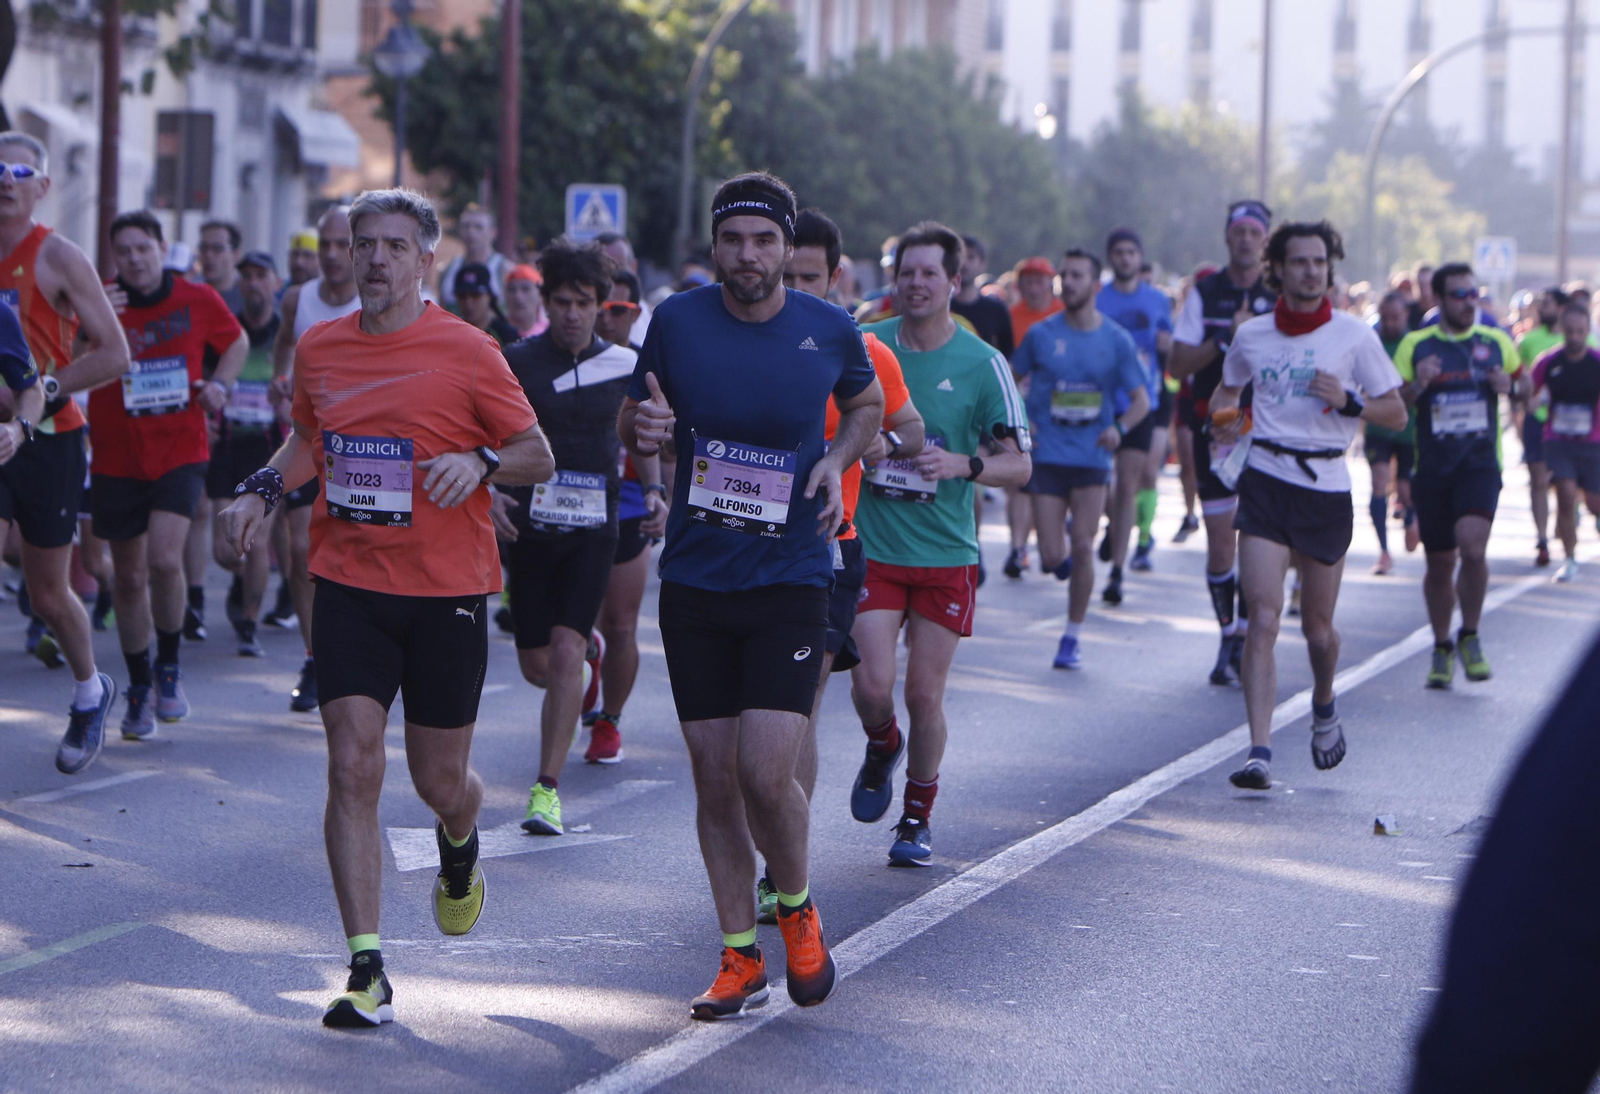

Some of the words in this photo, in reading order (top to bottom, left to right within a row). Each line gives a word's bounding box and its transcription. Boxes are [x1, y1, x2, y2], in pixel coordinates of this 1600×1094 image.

[721, 201, 773, 212] LURBEL
[798, 344, 819, 352] adidas
[141, 359, 180, 371] ZURICH
[345, 441, 401, 456] ZURICH
[728, 447, 785, 468] ZURICH
[345, 472, 382, 488] 7023
[560, 474, 599, 487] ZURICH
[885, 473, 908, 486] PAUL
[723, 477, 761, 496] 7394
[348, 493, 376, 506] JUAN
[556, 496, 584, 509] 9094
[712, 497, 763, 516] ALFONSO
[532, 509, 569, 521] RICARDO
[571, 512, 605, 524] RAPOSO
[760, 531, 781, 539] ZURICH
